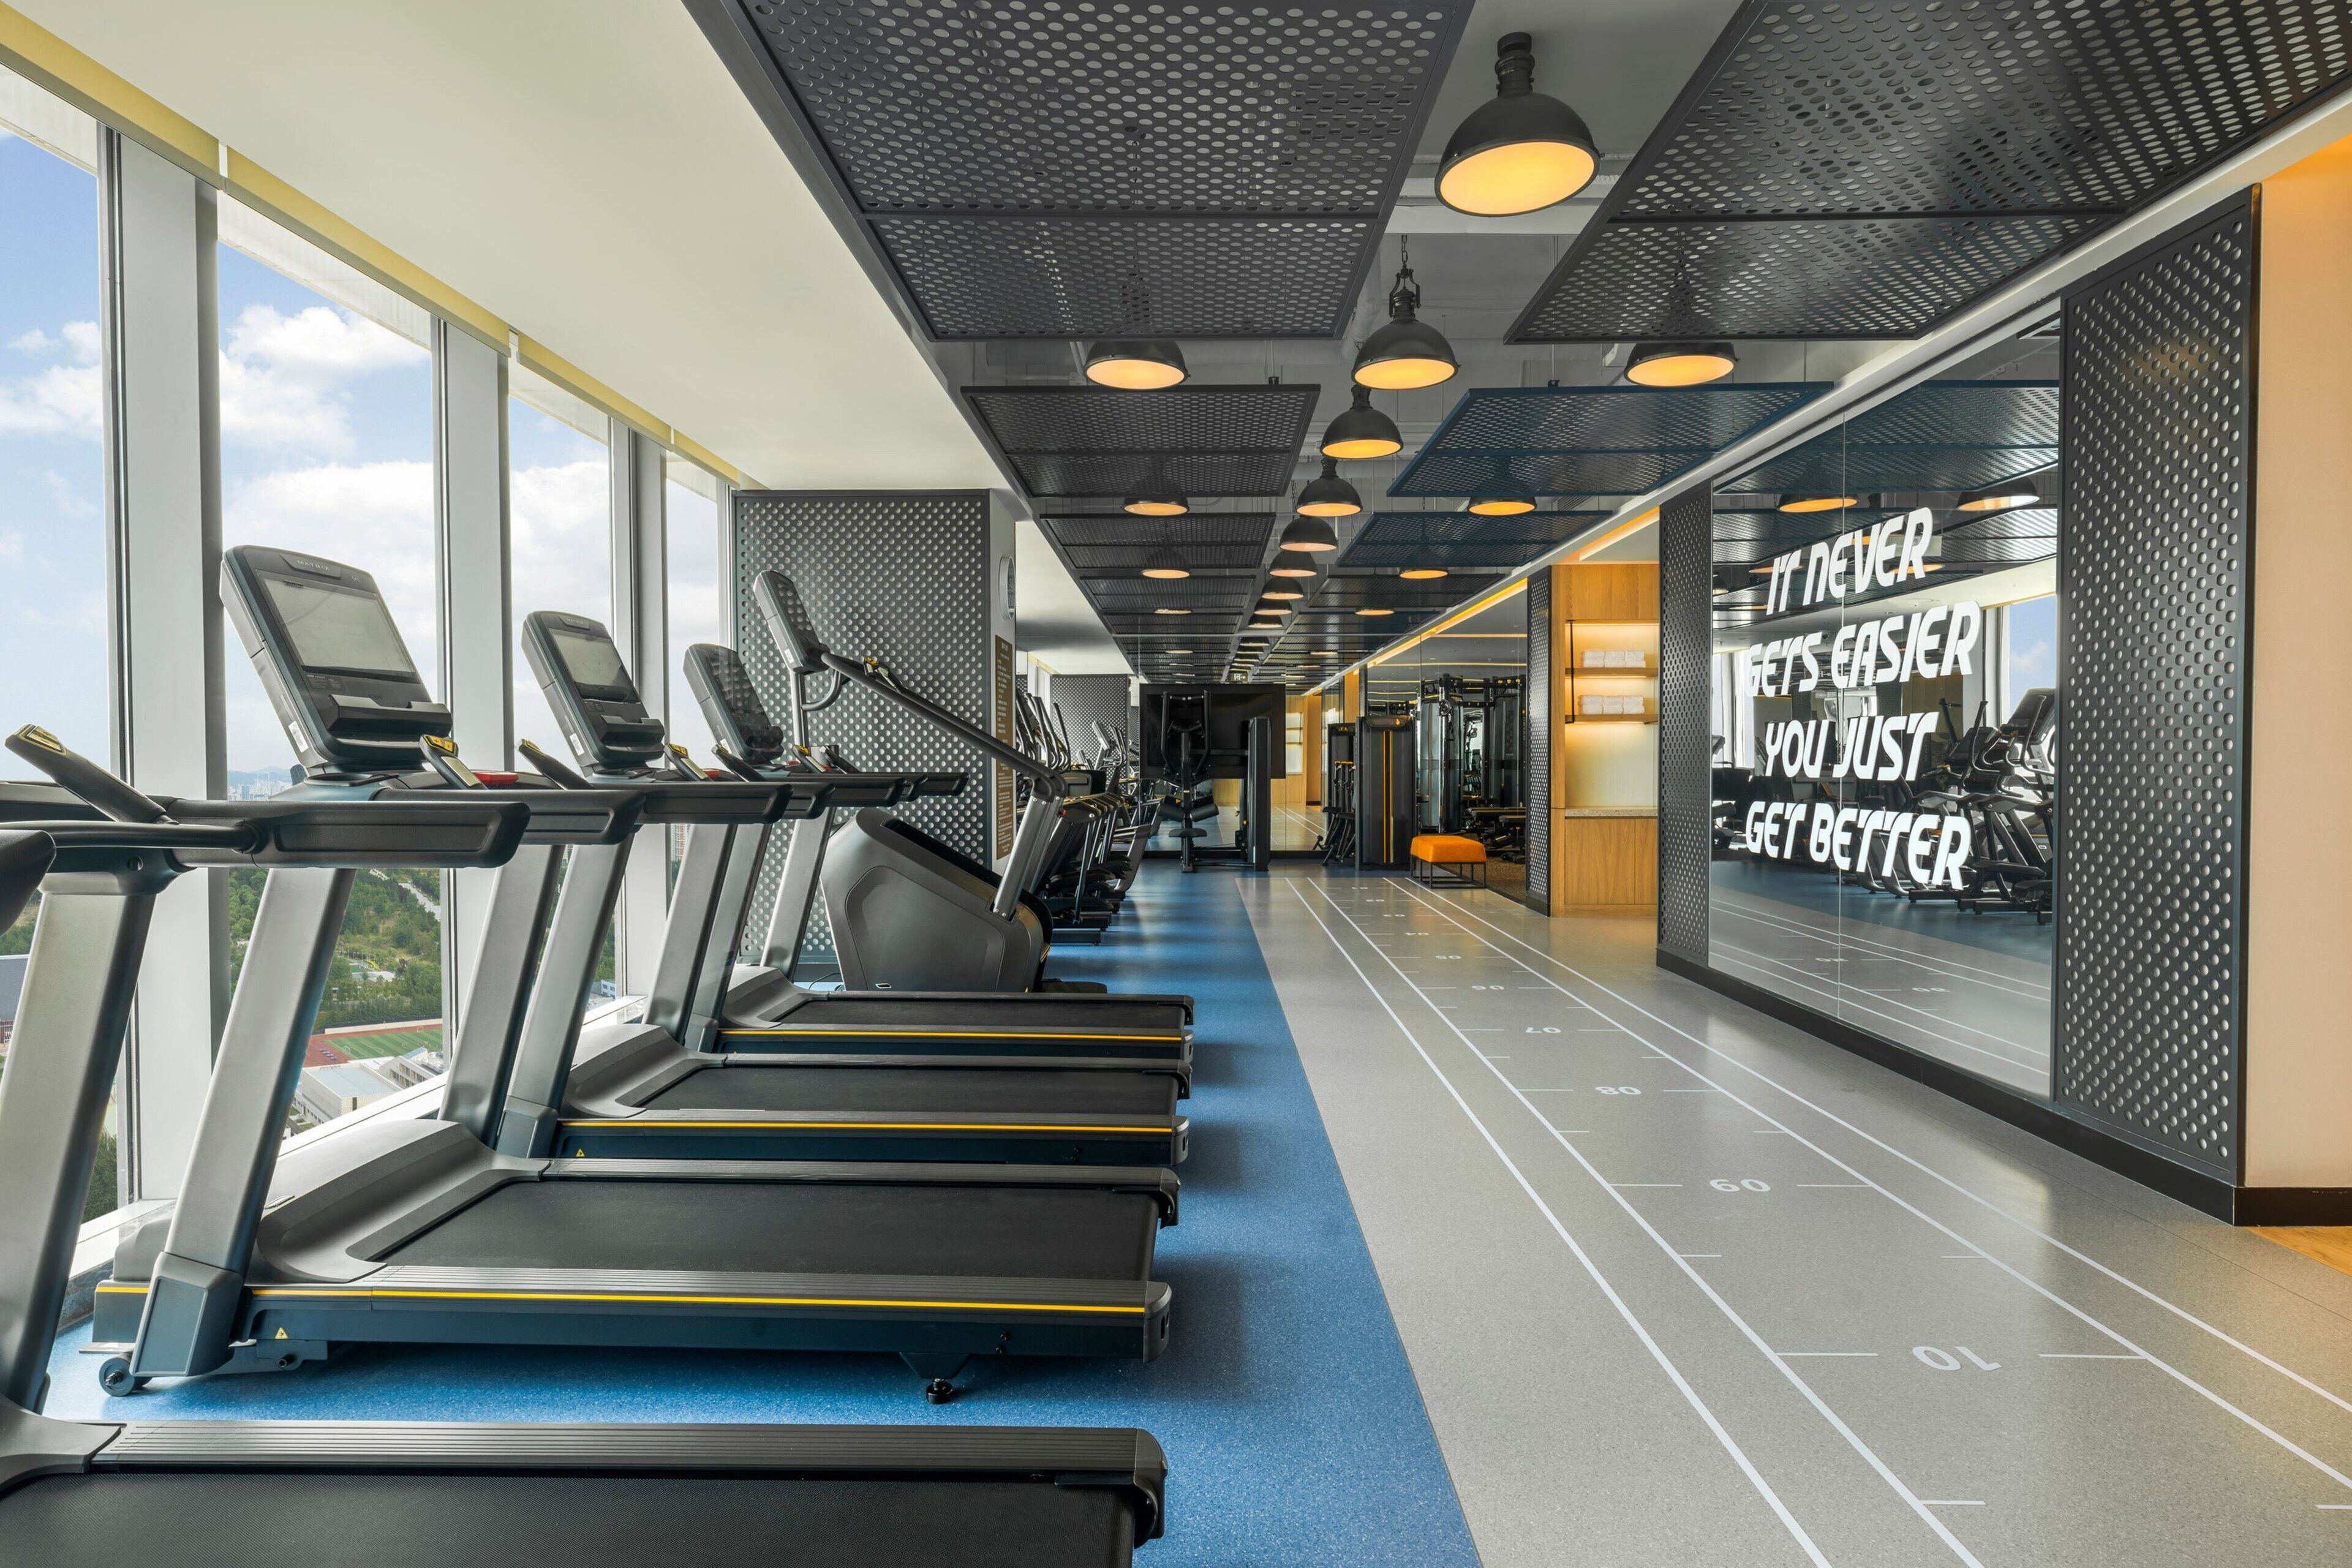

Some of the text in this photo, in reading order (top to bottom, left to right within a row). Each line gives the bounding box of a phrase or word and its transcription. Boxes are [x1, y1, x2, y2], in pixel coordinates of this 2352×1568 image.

[296, 559, 330, 571] MATRIX
[1766, 507, 1932, 616] IT NEVER
[1746, 601, 1981, 698] GETS EASIER
[1765, 718, 1830, 778] YOU
[1833, 712, 1940, 781] JUST
[1746, 801, 1971, 890] GET BETTER
